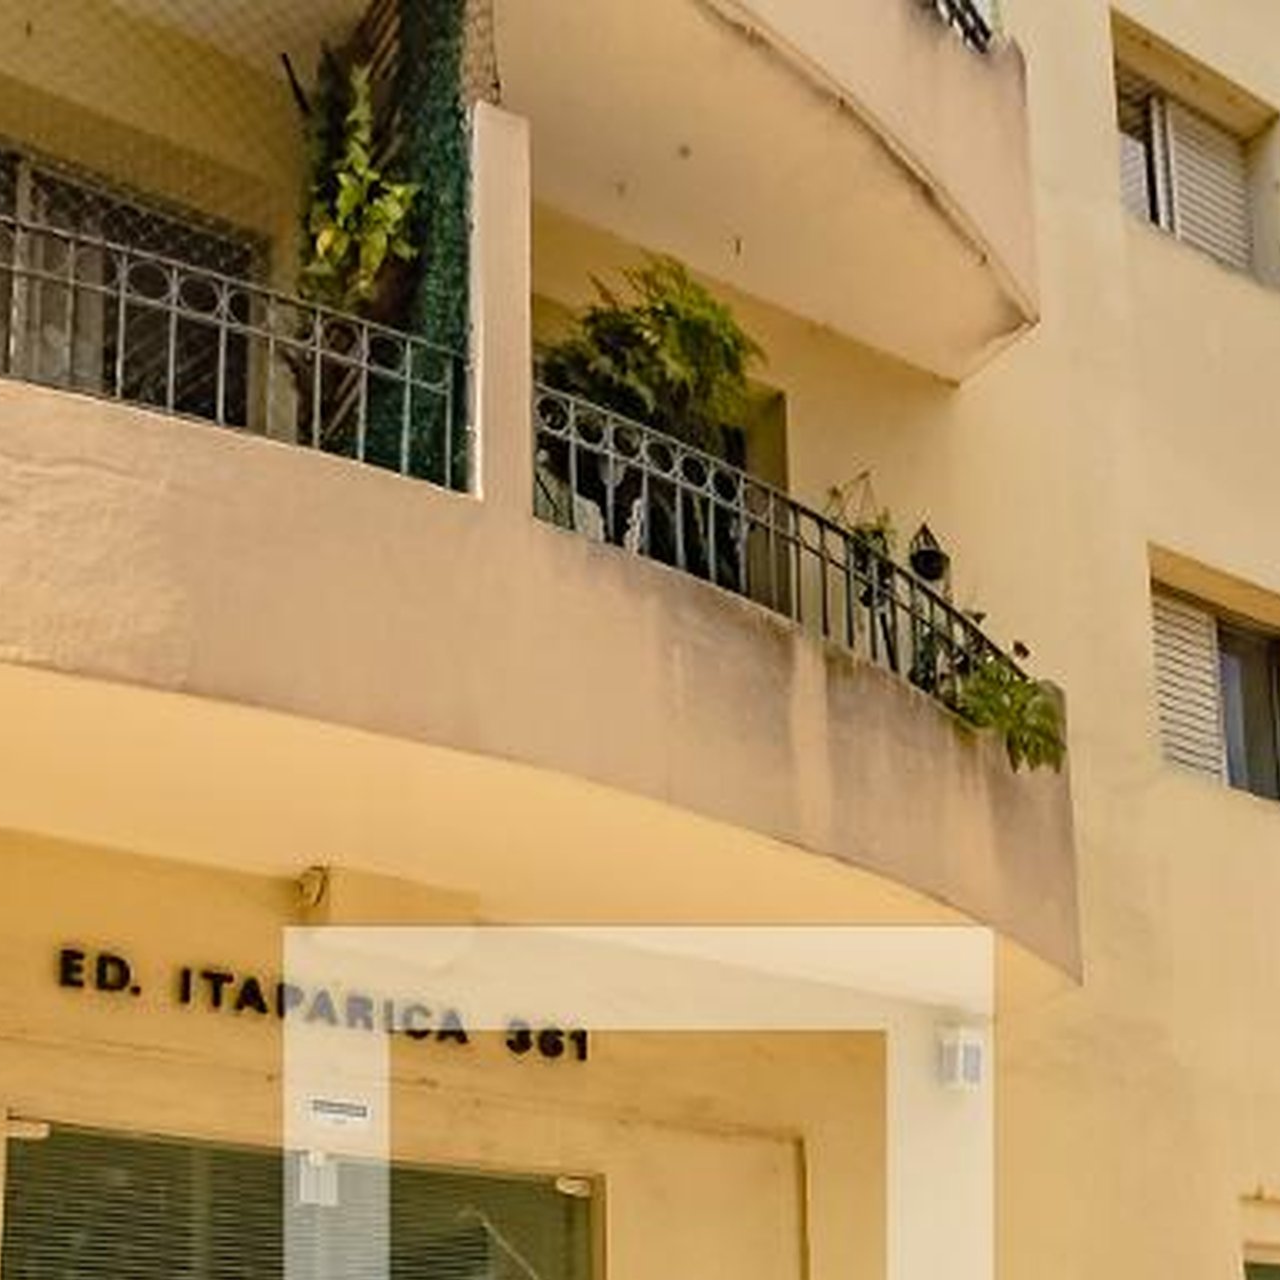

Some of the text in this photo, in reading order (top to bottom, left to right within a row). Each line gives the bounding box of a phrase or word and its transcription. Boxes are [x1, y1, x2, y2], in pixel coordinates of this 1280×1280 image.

[58, 949, 588, 1061] ED. ITAPARICA 361
